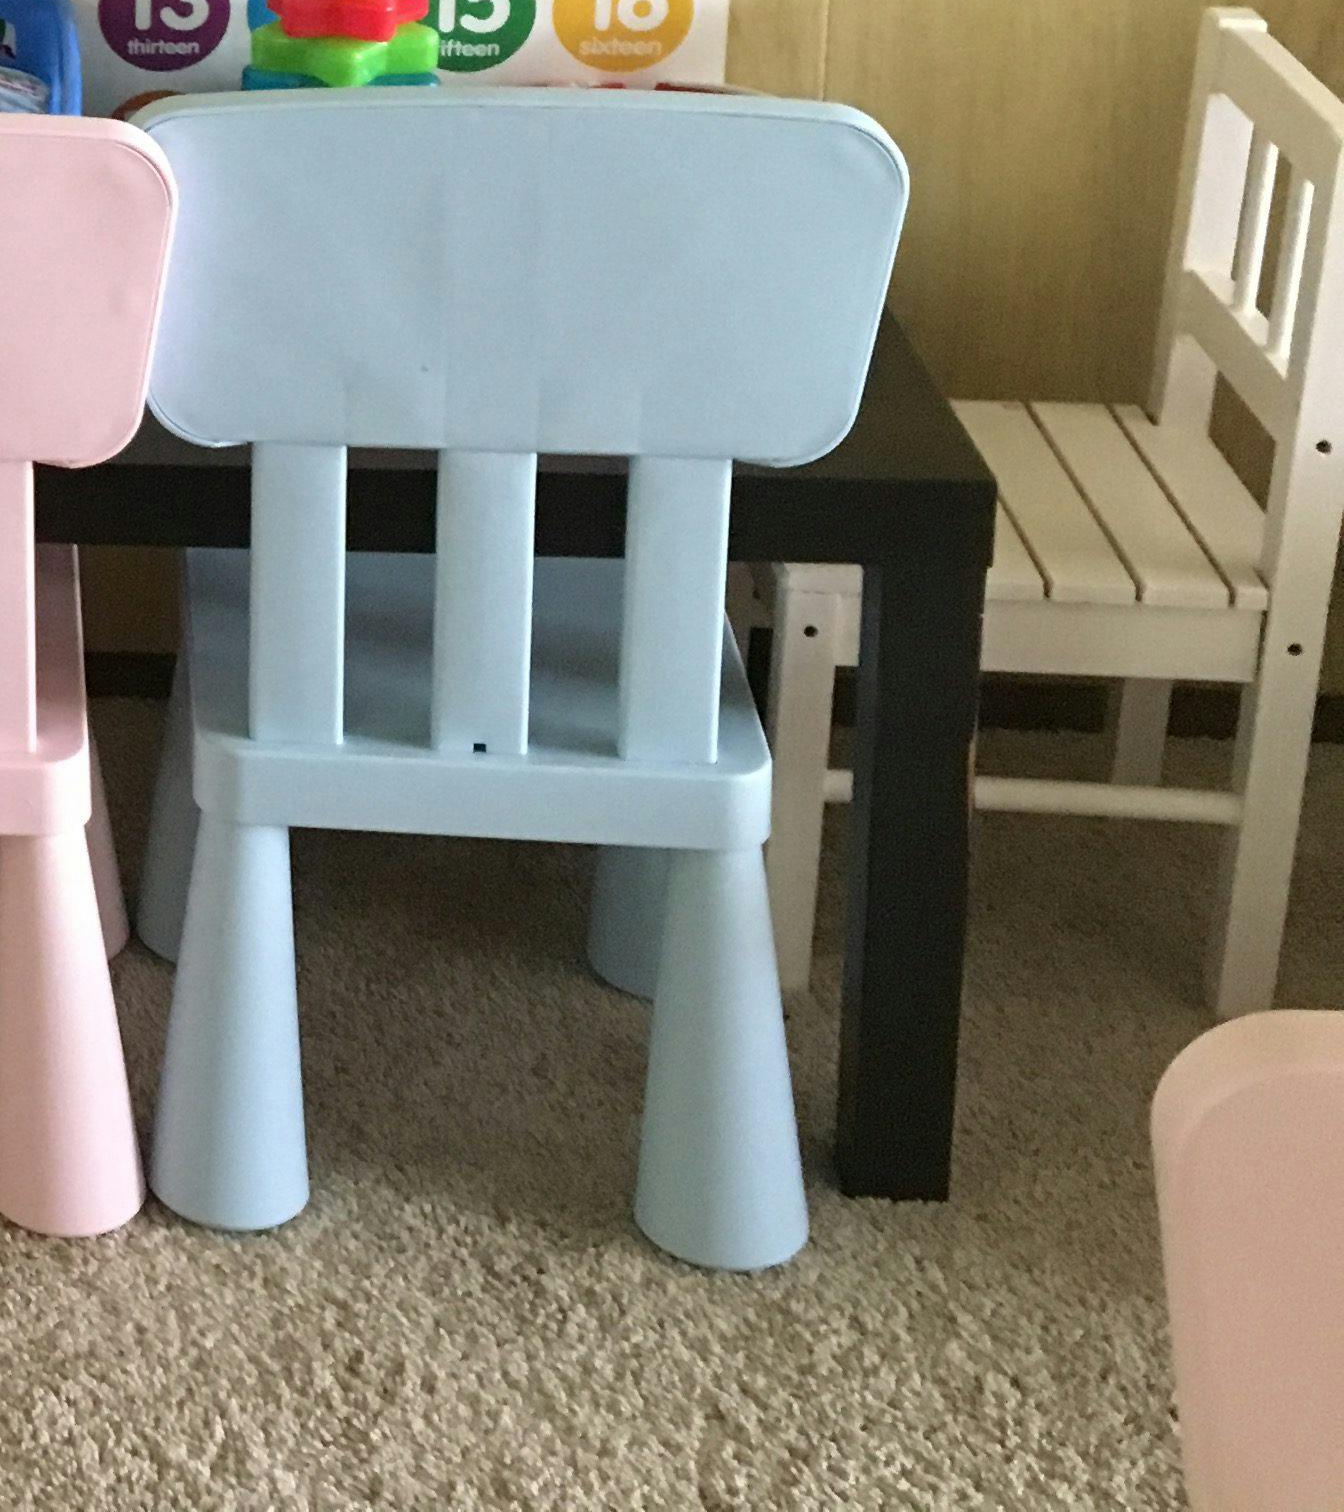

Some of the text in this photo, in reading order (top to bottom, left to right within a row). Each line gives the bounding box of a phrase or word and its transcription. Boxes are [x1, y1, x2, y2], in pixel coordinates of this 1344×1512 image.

[127, 39, 199, 55] thirteen
[438, 40, 500, 58] ifteen
[579, 36, 662, 55] sixteen
